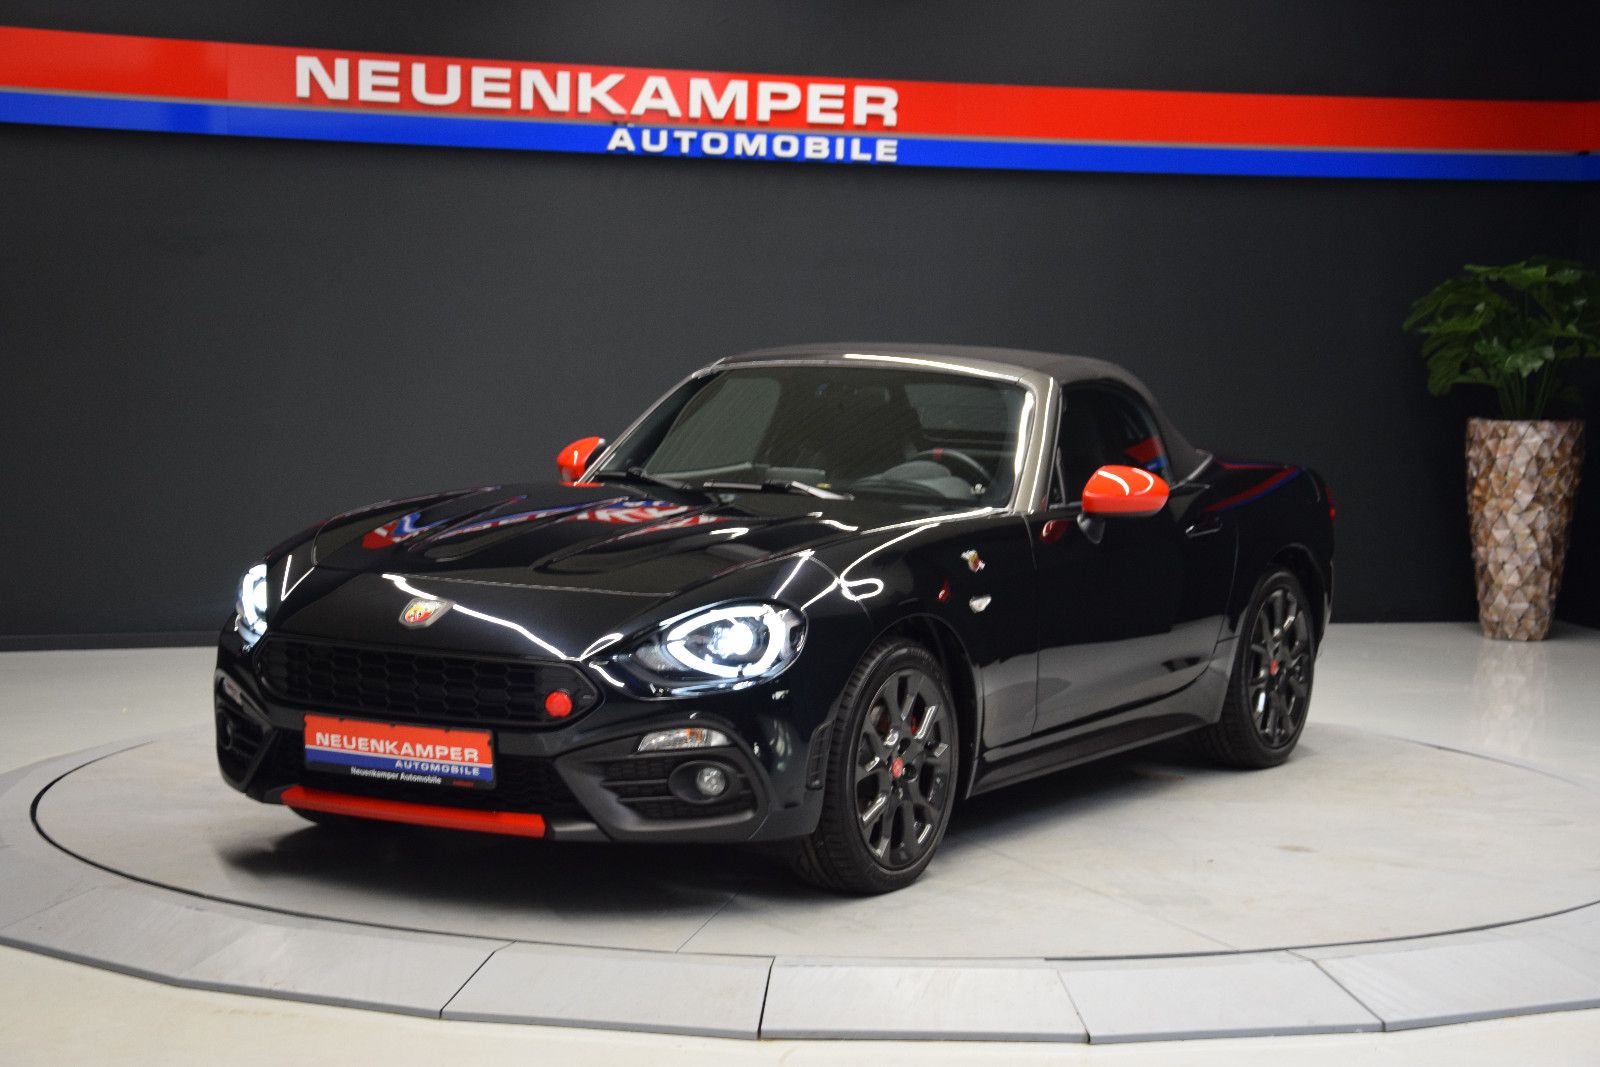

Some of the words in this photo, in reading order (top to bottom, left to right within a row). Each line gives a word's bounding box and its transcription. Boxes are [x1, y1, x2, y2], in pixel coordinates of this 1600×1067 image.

[296, 55, 899, 127] NEUENKAMPER
[607, 128, 899, 163] AUTOMOBILE
[315, 732, 479, 762] NEUENKAMPER
[350, 766, 400, 781] Neuenkamper
[400, 772, 442, 784] Automobile
[395, 759, 481, 776] AUTOMOBILE
